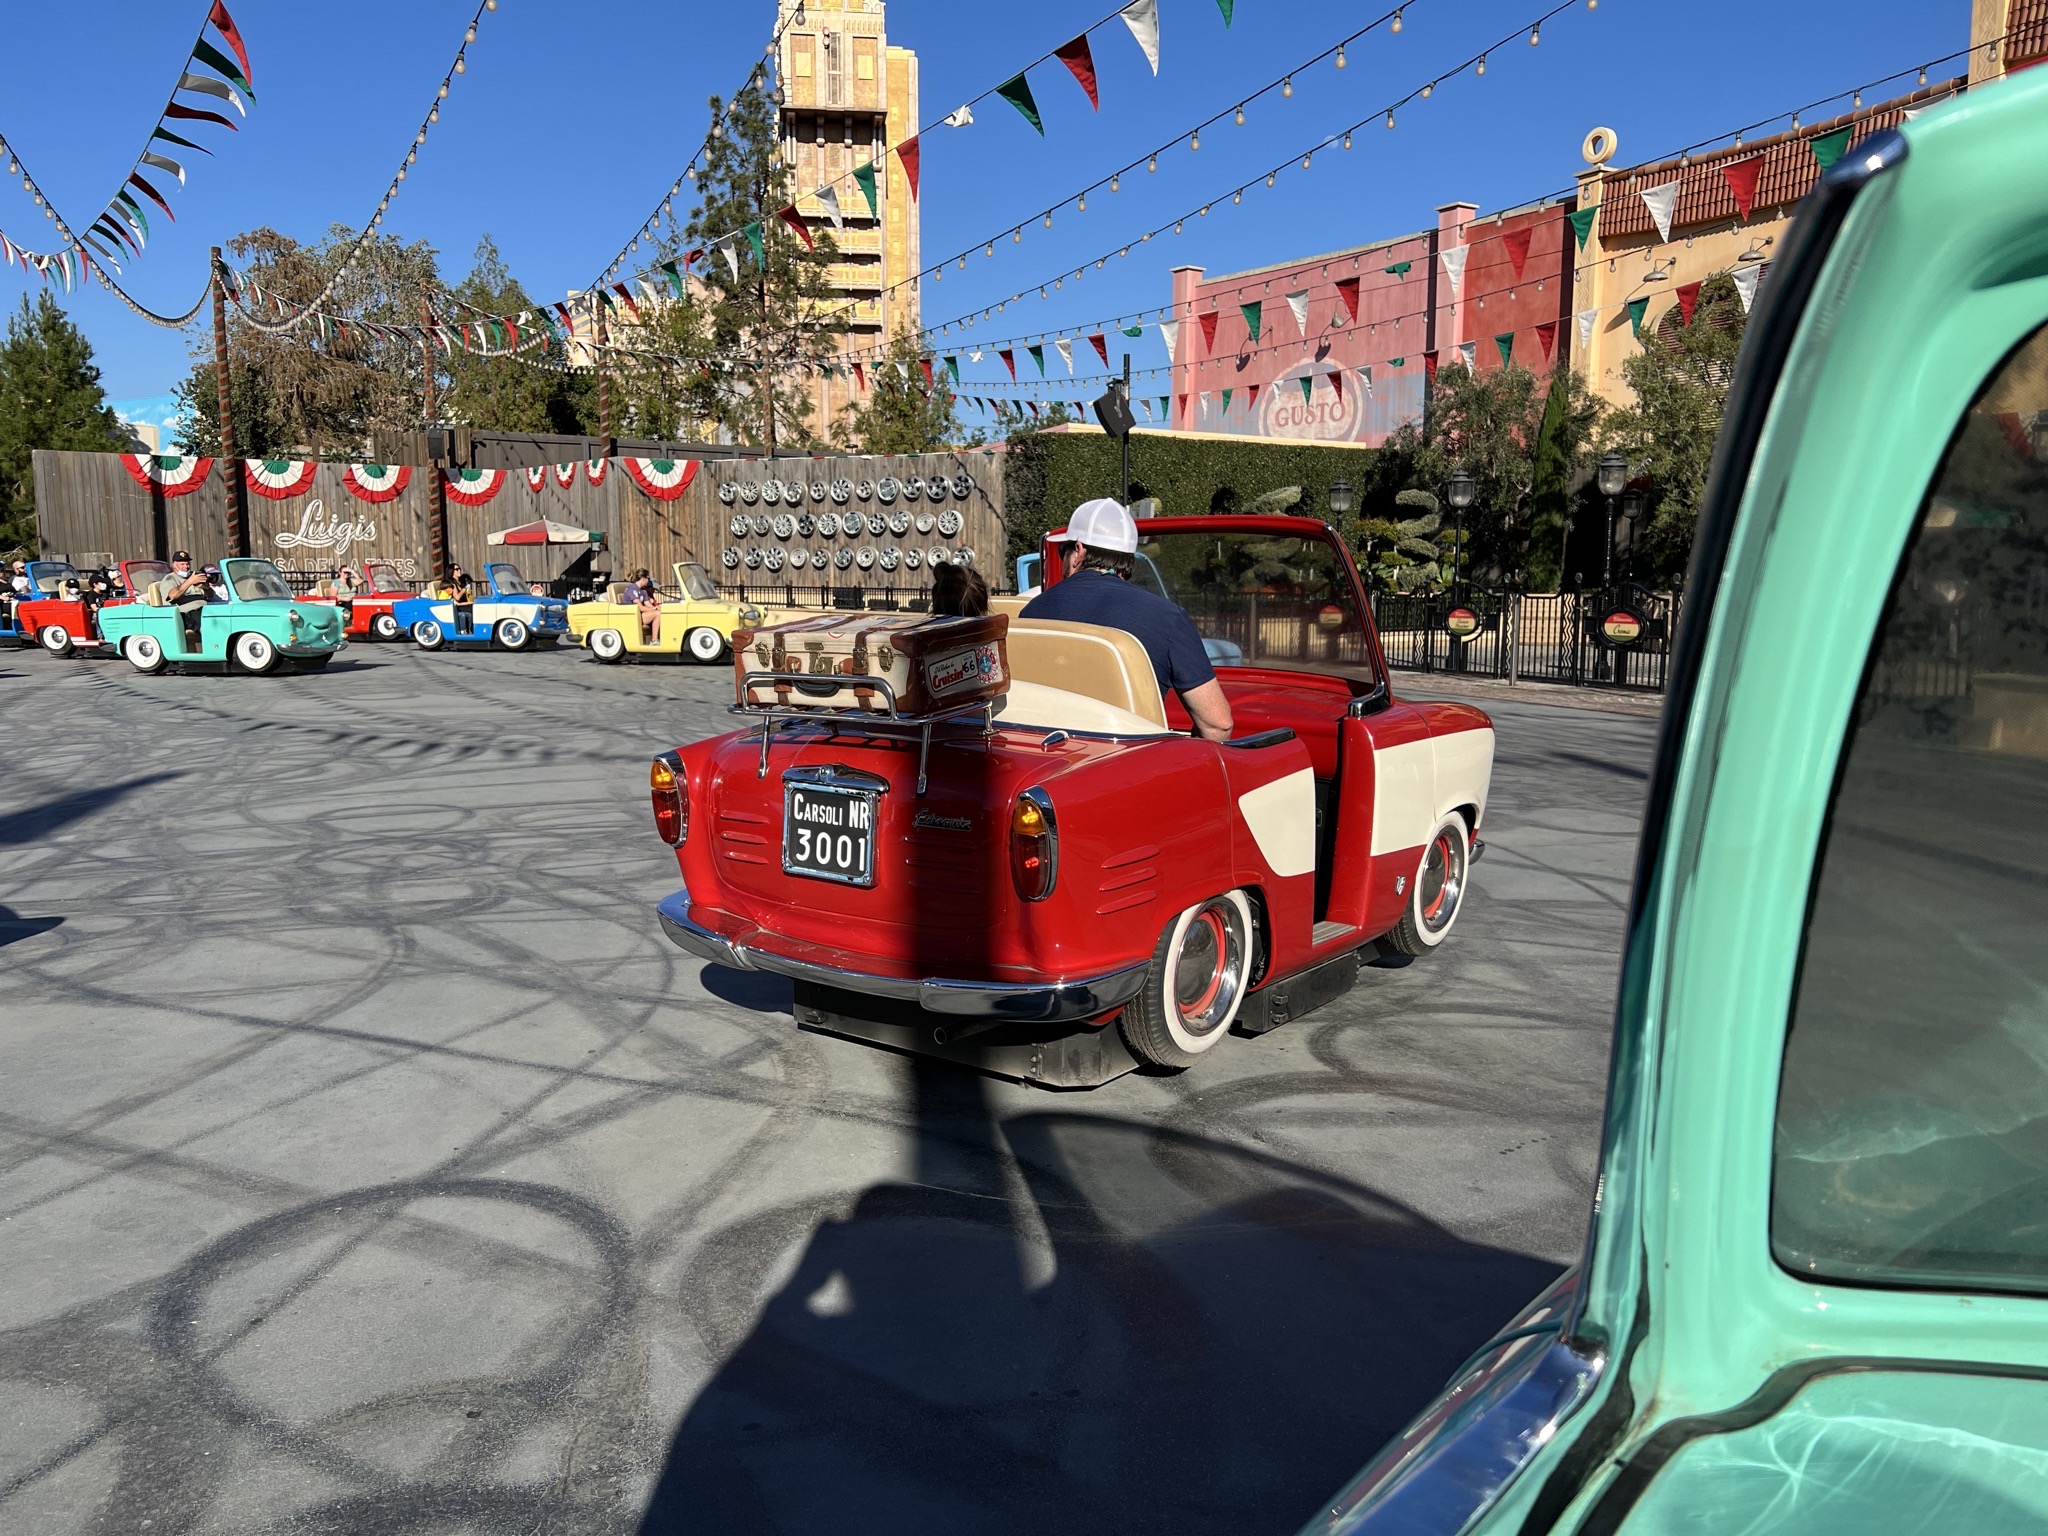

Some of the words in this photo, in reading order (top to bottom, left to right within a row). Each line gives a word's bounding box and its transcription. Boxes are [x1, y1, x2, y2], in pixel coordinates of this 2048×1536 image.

[1275, 402, 1345, 428] GUSTO
[963, 660, 976, 673] 66
[849, 800, 870, 830] NR
[796, 828, 866, 871] 3001
